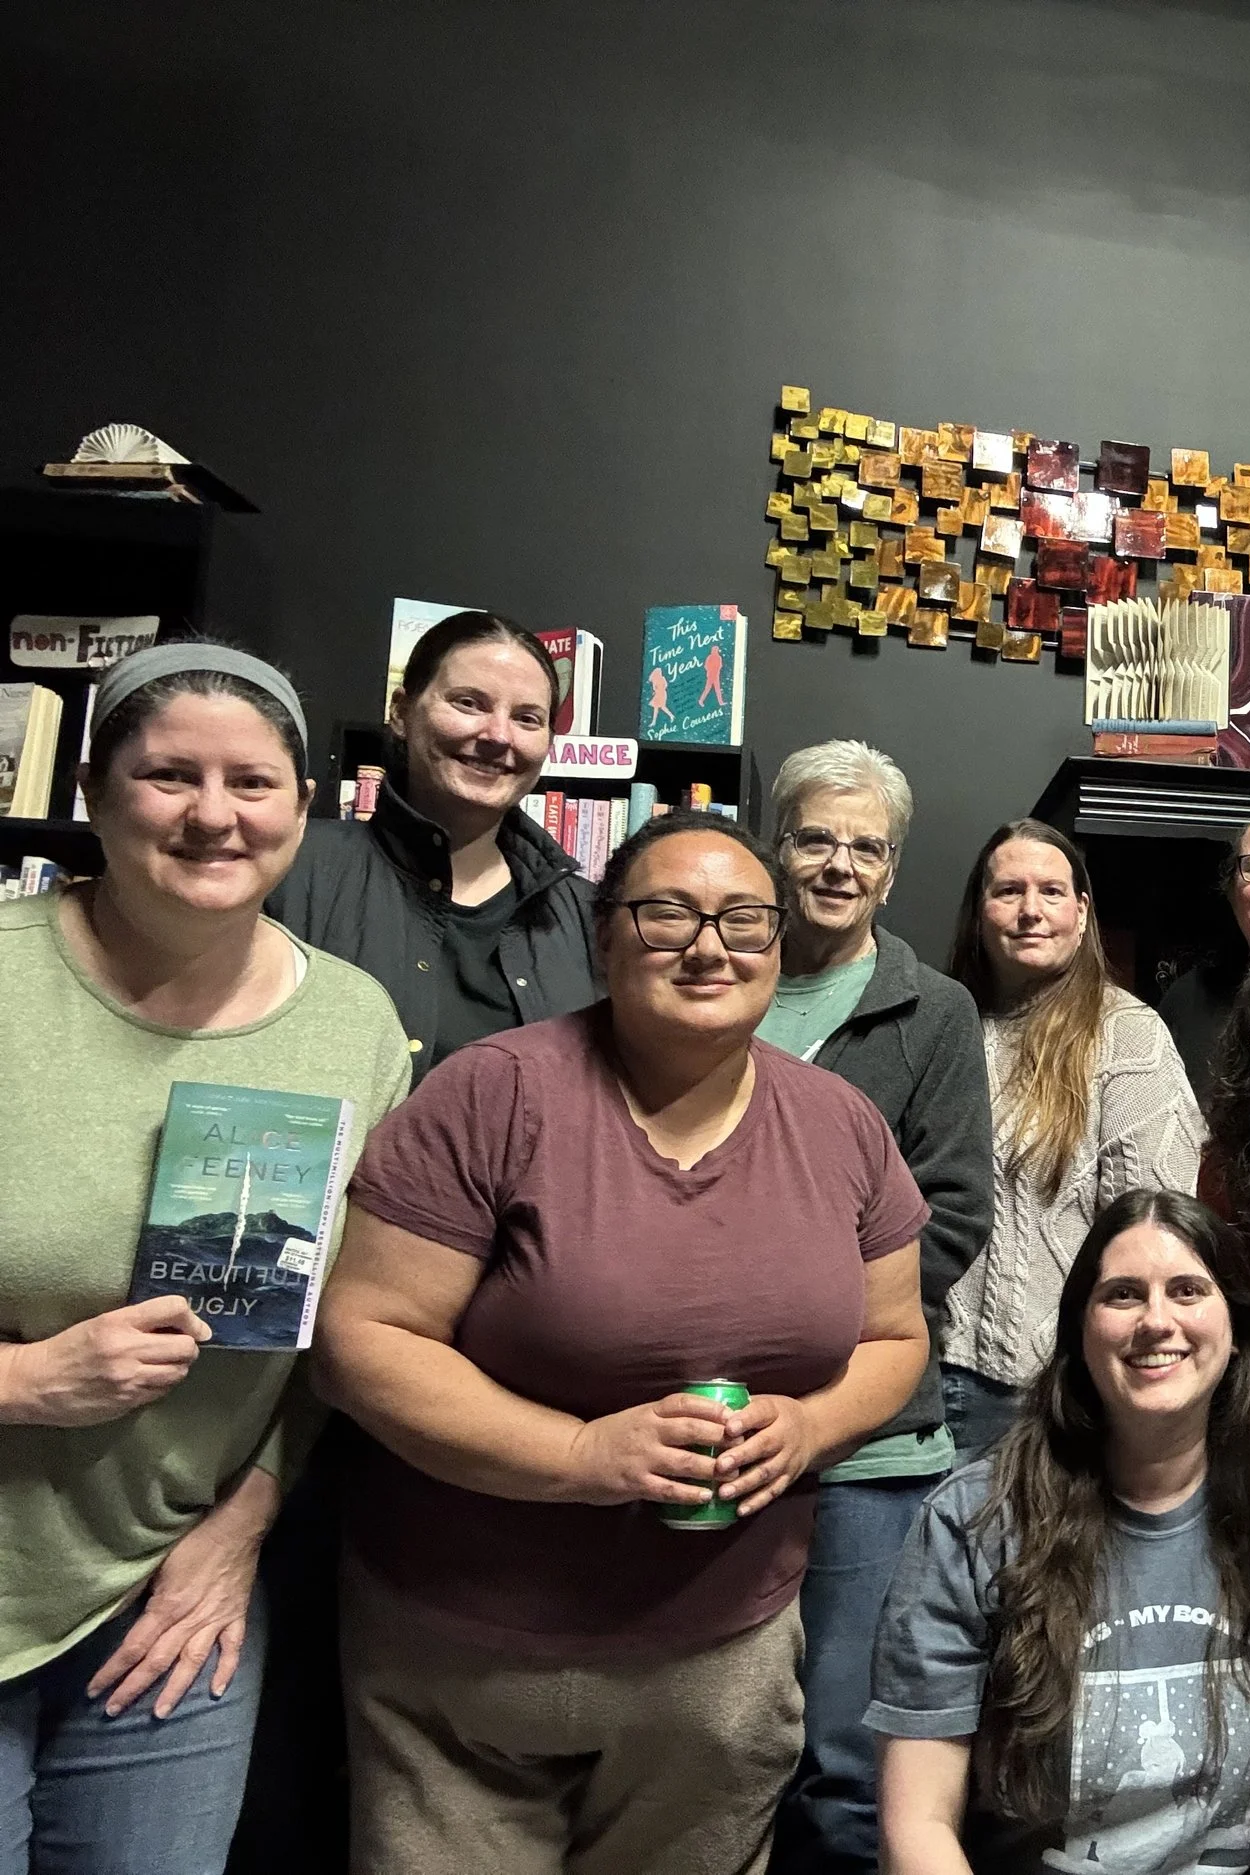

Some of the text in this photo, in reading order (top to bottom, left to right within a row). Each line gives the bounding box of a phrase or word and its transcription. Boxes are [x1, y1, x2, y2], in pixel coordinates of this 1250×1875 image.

[668, 617, 697, 641] This
[650, 626, 724, 666] Time Next
[665, 656, 703, 683] Year
[647, 708, 723, 740] Sophie Cousens
[337, 1121, 346, 1137] THE
[309, 1229, 325, 1288] BESTSELLING
[301, 1290, 314, 1327] AUTHOR
[1128, 1605, 1171, 1628] MY
